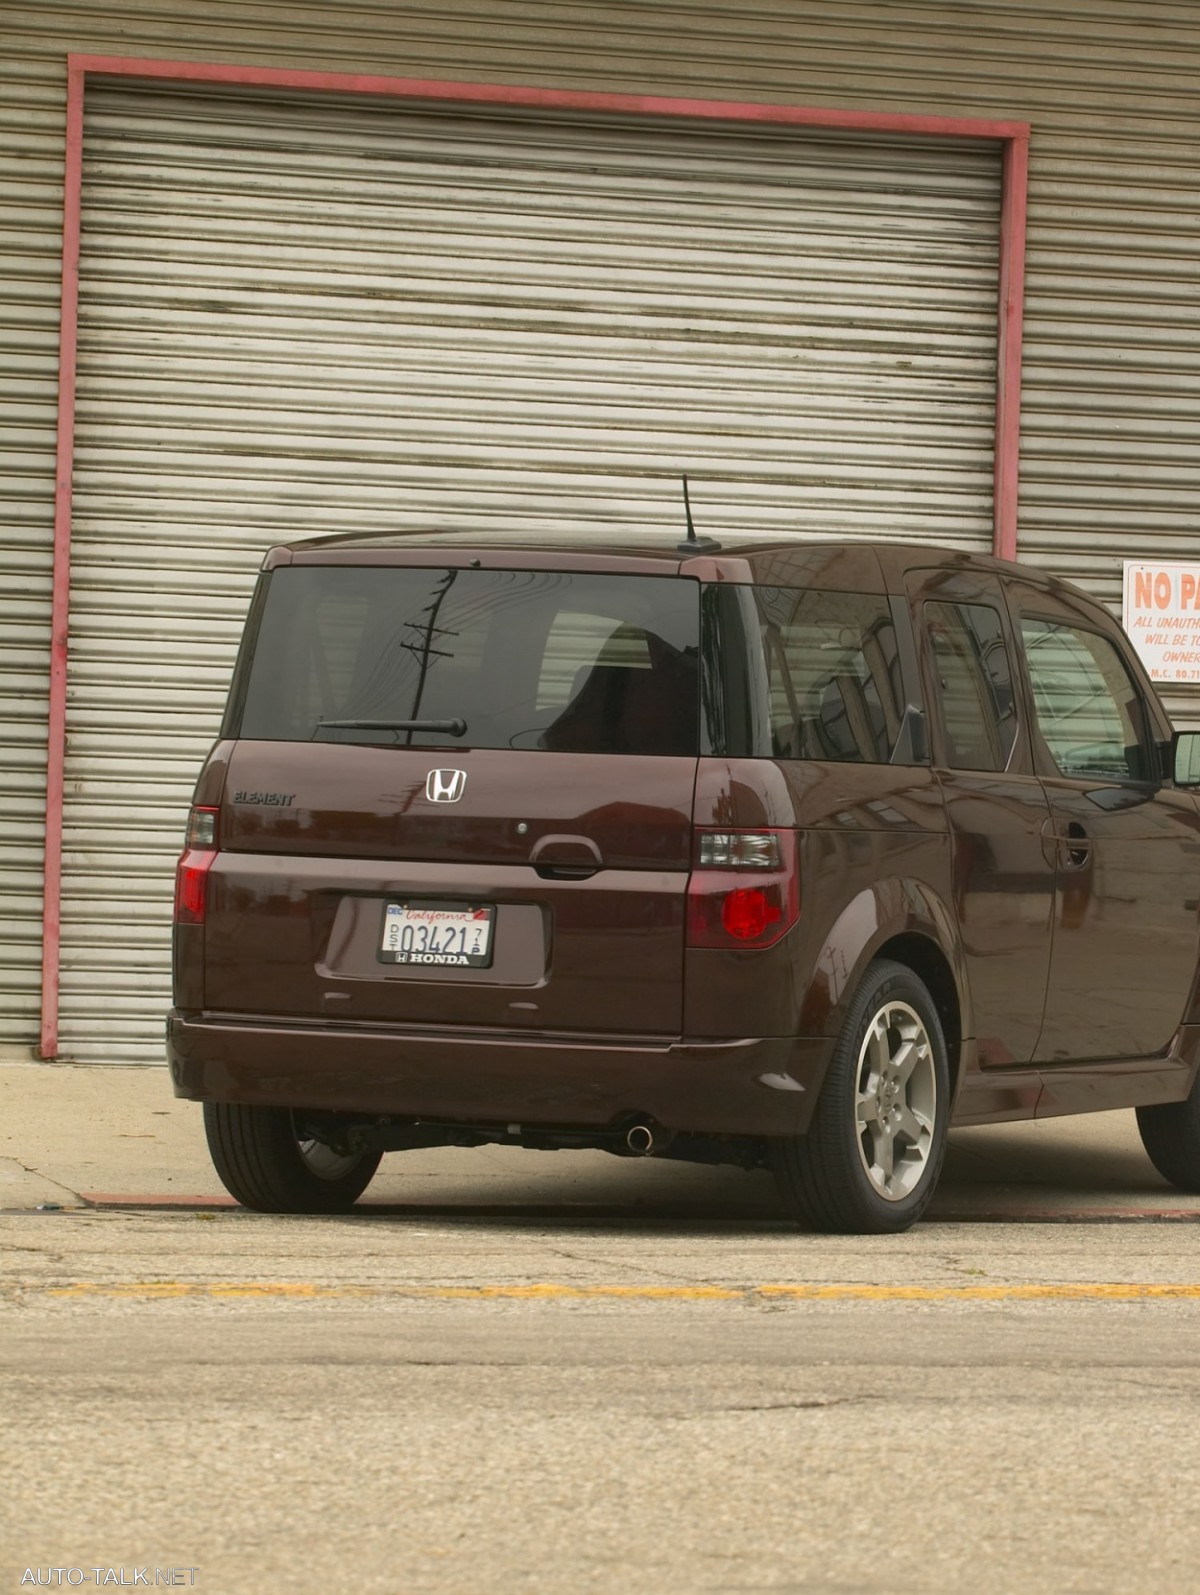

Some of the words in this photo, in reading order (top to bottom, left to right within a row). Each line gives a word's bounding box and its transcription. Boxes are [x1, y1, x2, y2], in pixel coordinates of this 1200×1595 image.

[1135, 572, 1171, 610] NO
[1133, 616, 1153, 628] ALL
[1145, 633, 1169, 645] WILL
[1172, 634, 1188, 646] BE
[387, 907, 403, 915] DEC
[406, 909, 472, 924] California
[401, 925, 467, 954] 03421
[410, 953, 469, 965] HONDA
